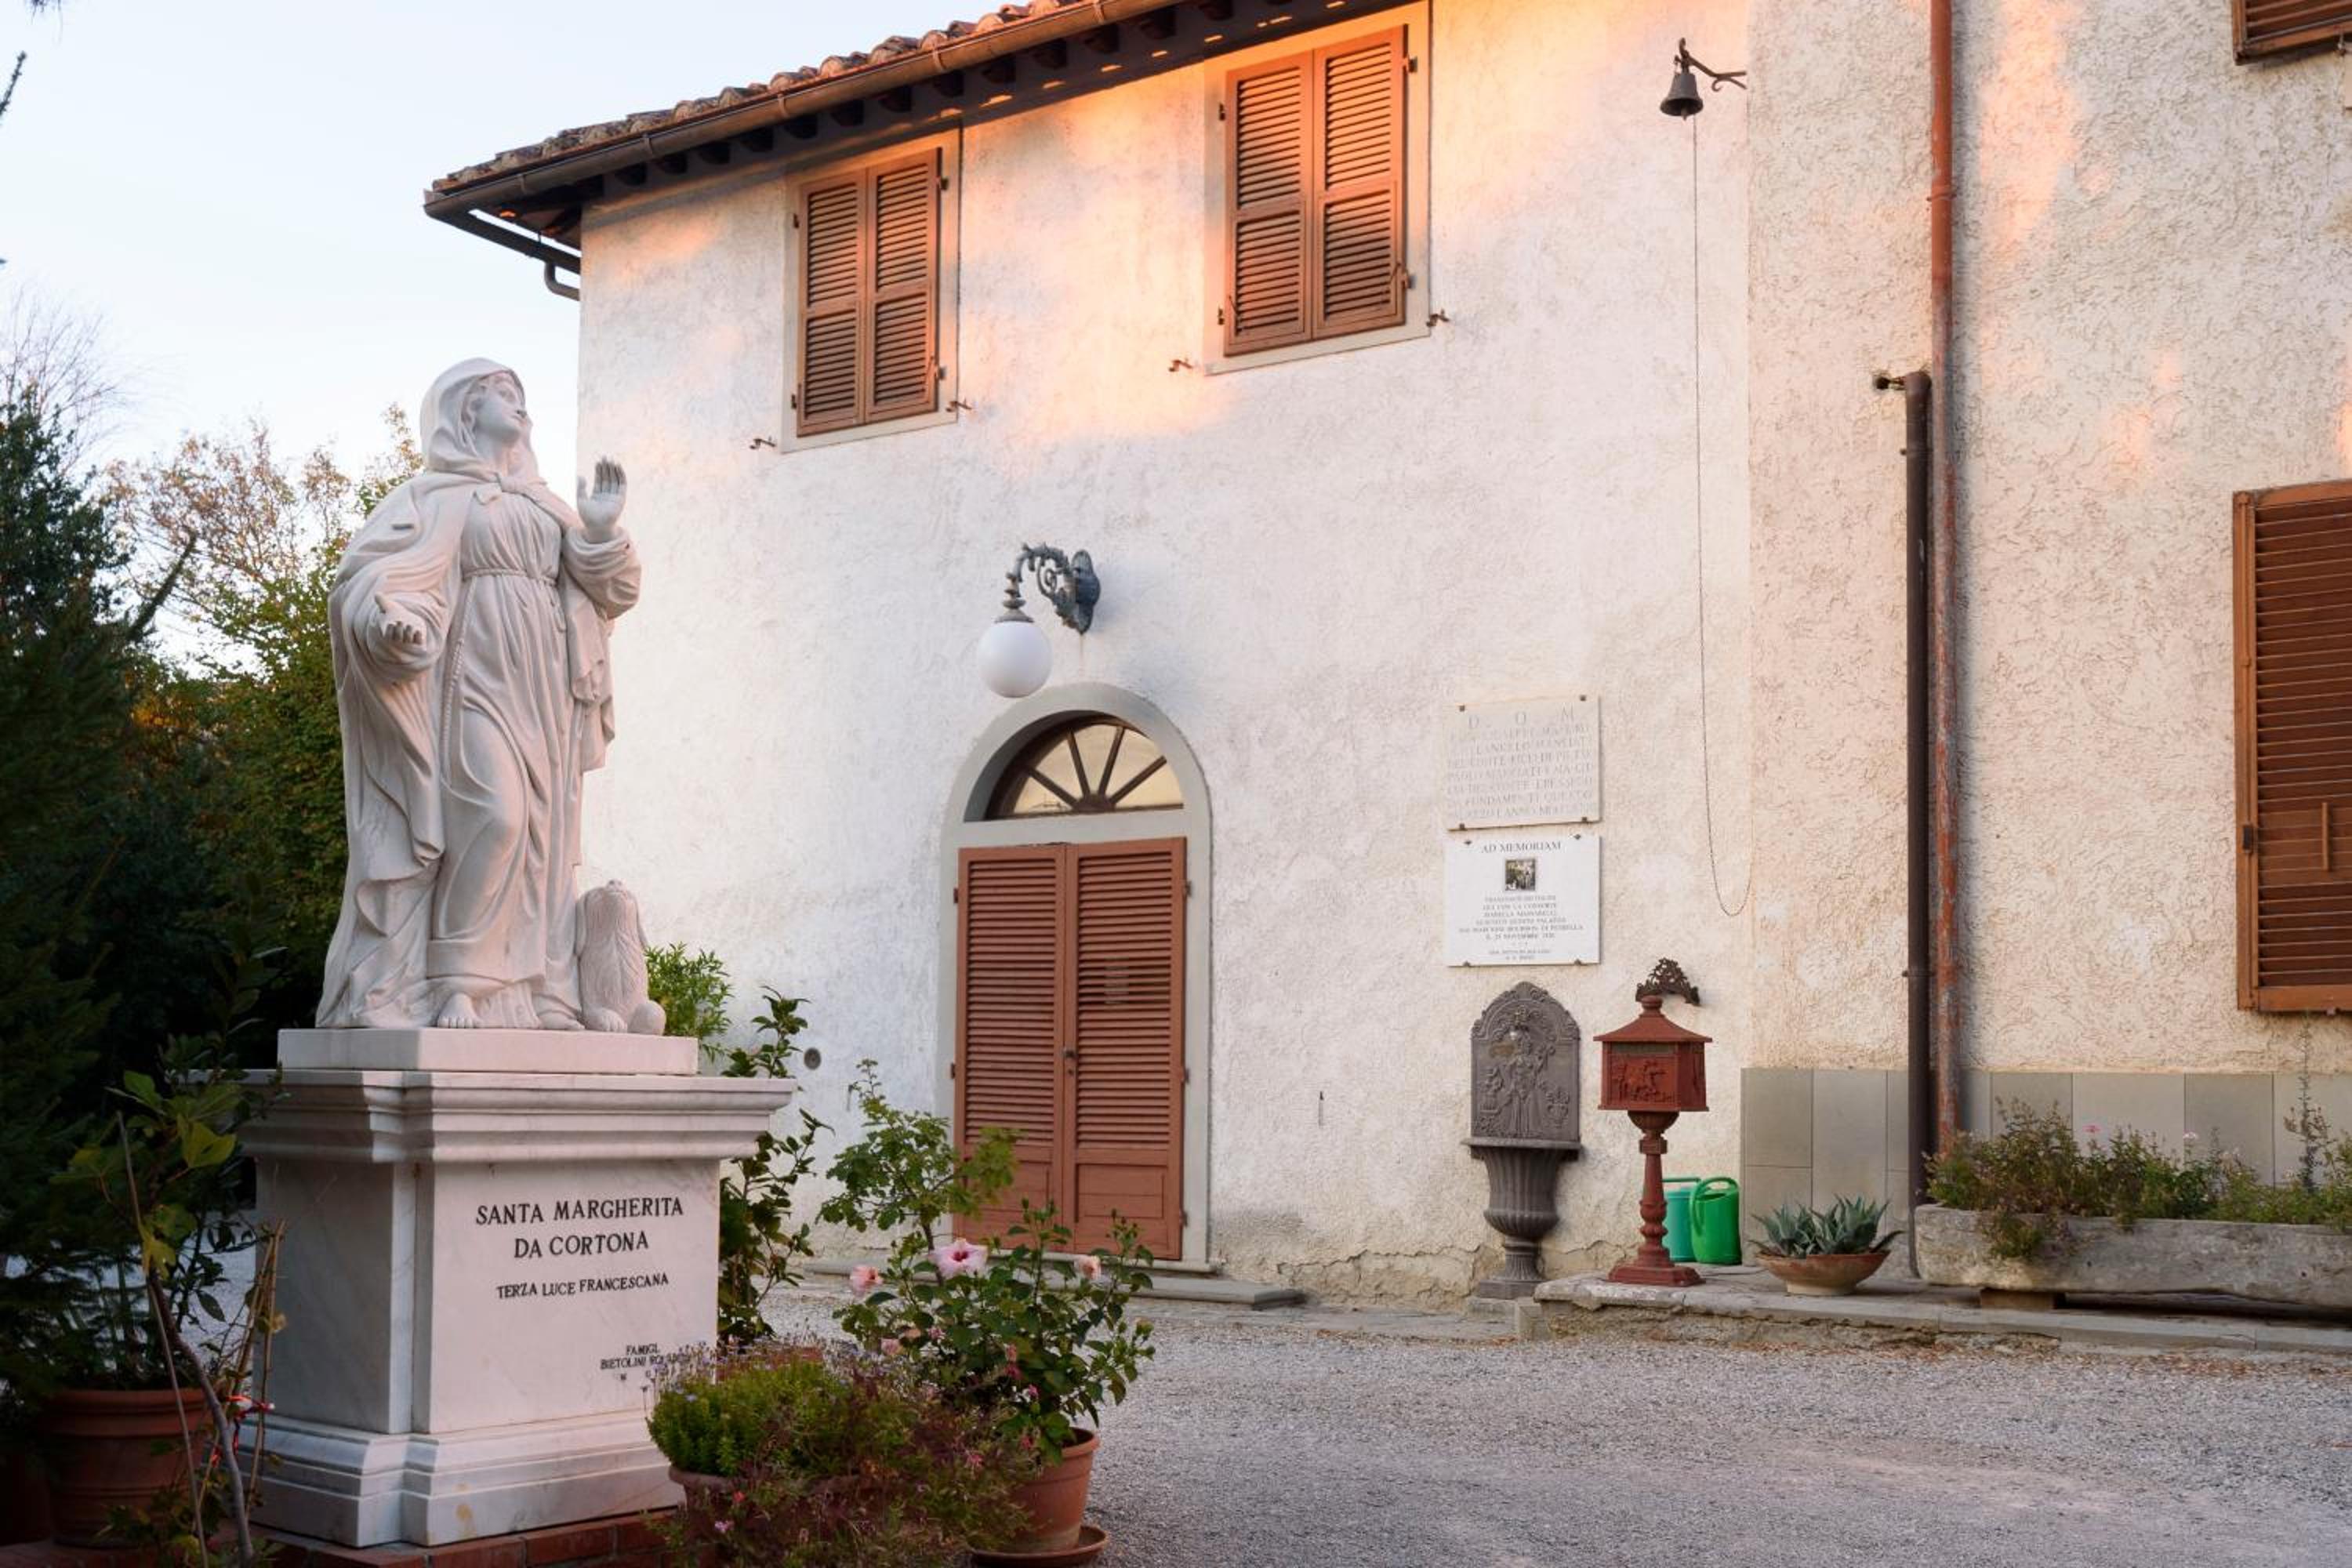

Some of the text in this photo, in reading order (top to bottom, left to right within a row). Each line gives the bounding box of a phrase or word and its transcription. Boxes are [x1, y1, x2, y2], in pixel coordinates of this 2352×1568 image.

[1481, 840, 1561, 853] AD MEMORIAM
[476, 1196, 684, 1225] SANTA MARGHERITA
[514, 1230, 649, 1258] DA CORTONA
[496, 1272, 669, 1299] TERZA LUCE FRANCESCANA
